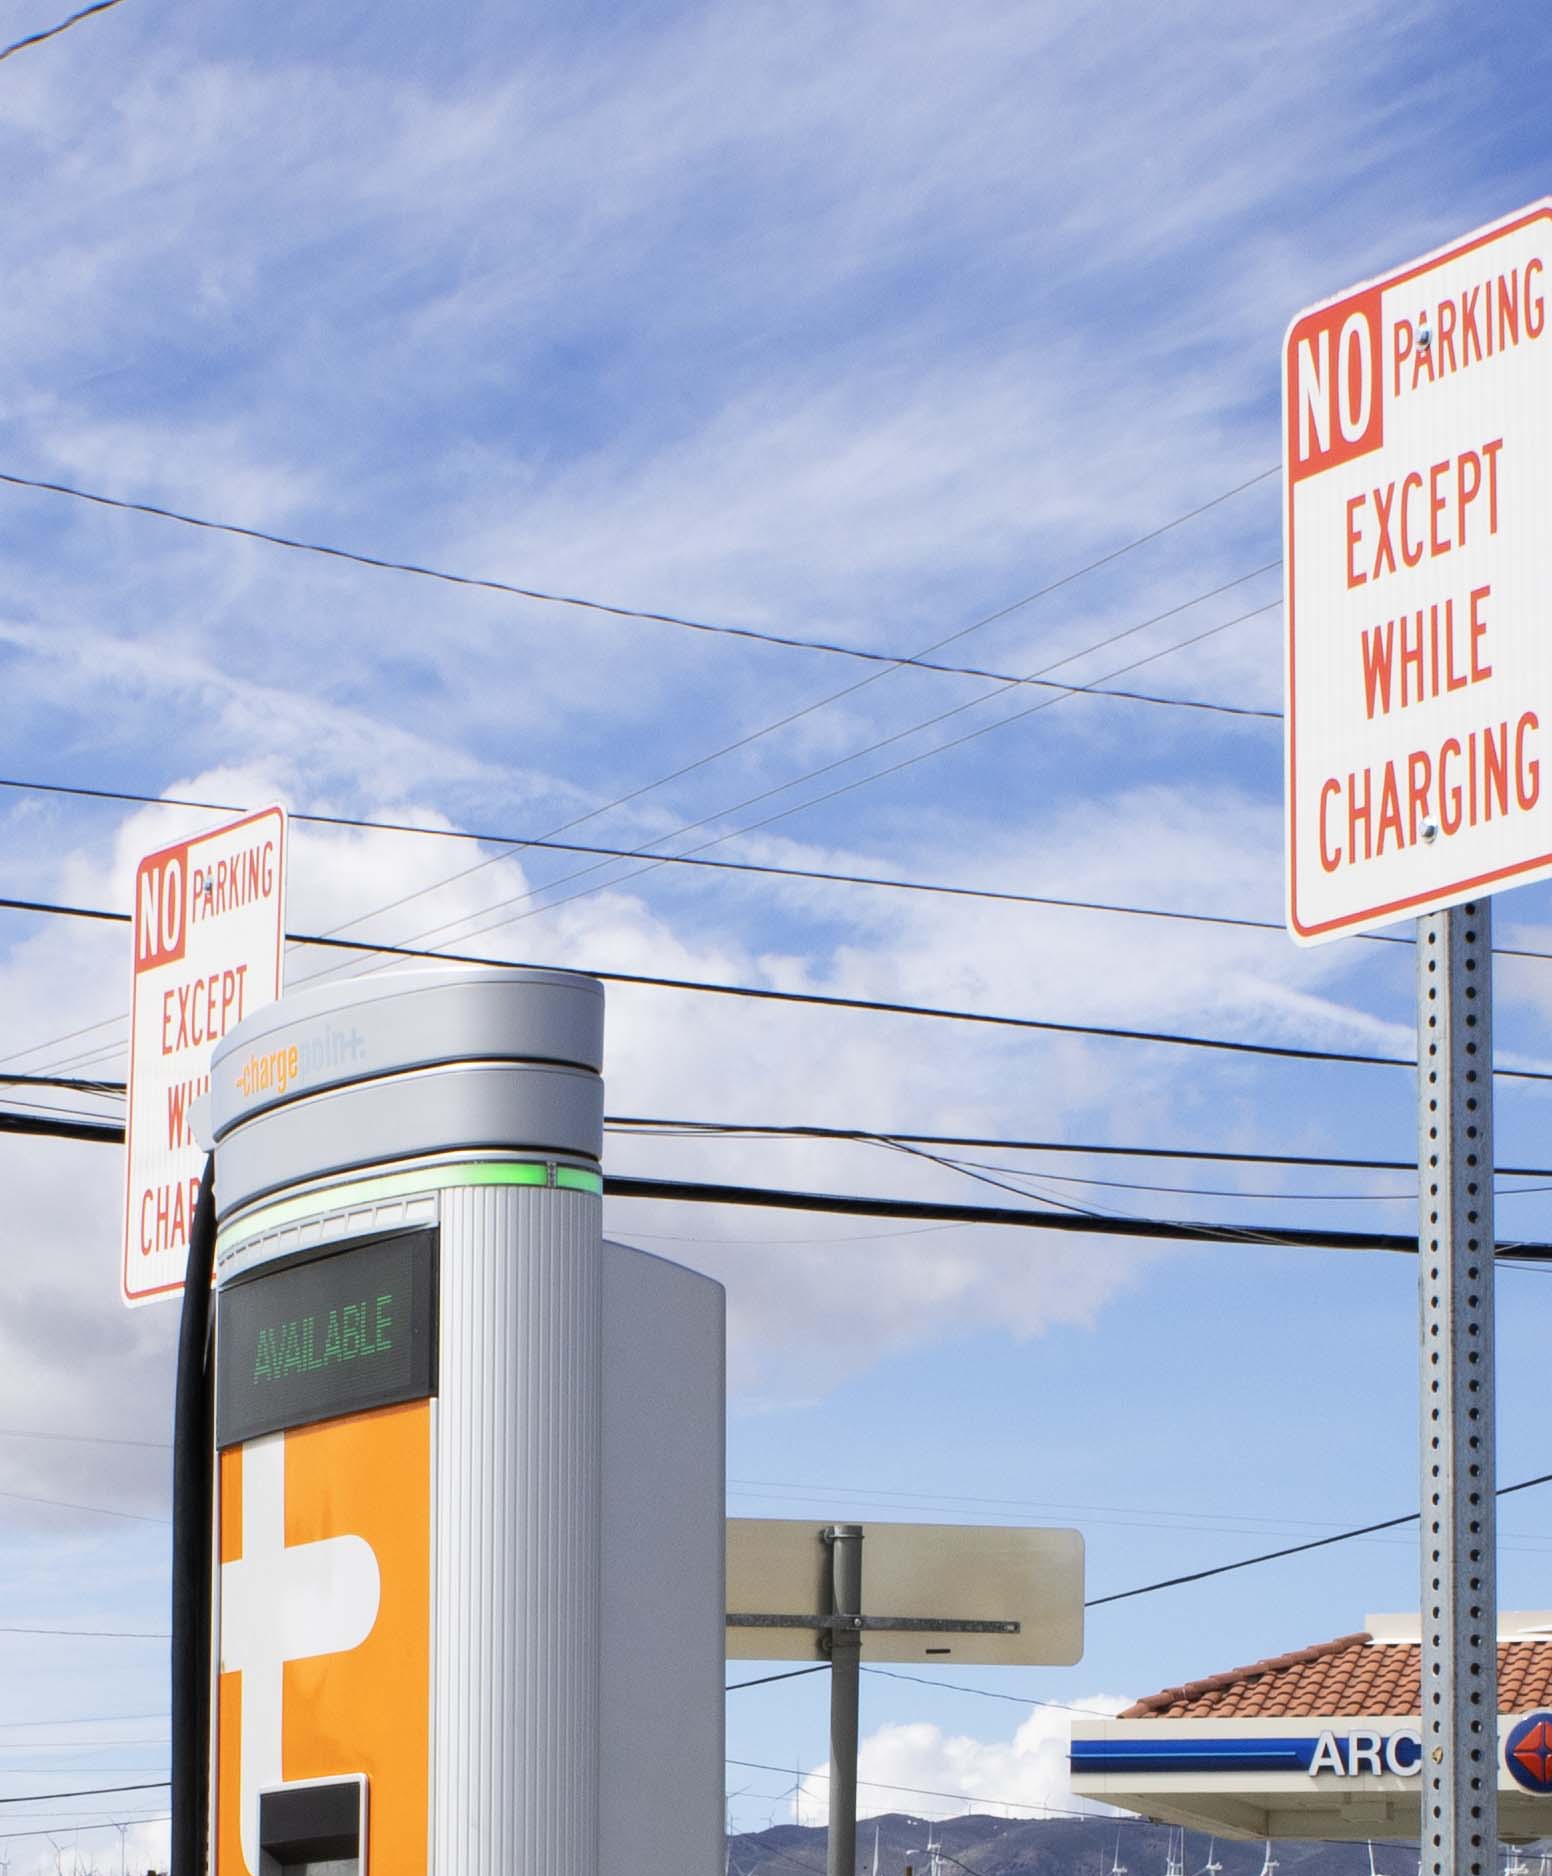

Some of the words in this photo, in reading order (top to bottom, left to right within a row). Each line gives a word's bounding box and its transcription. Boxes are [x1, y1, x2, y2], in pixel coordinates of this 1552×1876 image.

[1296, 311, 1373, 464] NO
[1392, 257, 1546, 399] PARKING
[1346, 437, 1504, 590] EXCEPT
[1361, 584, 1493, 720] WHILE
[1319, 711, 1541, 874] CHARGING
[140, 858, 182, 960] NO
[192, 840, 274, 924] PARKING
[162, 964, 247, 1056] EXCEPT
[141, 1177, 202, 1256] CHAR
[254, 1295, 393, 1384] AVAILABLE
[1308, 1729, 1422, 1777] ARC
